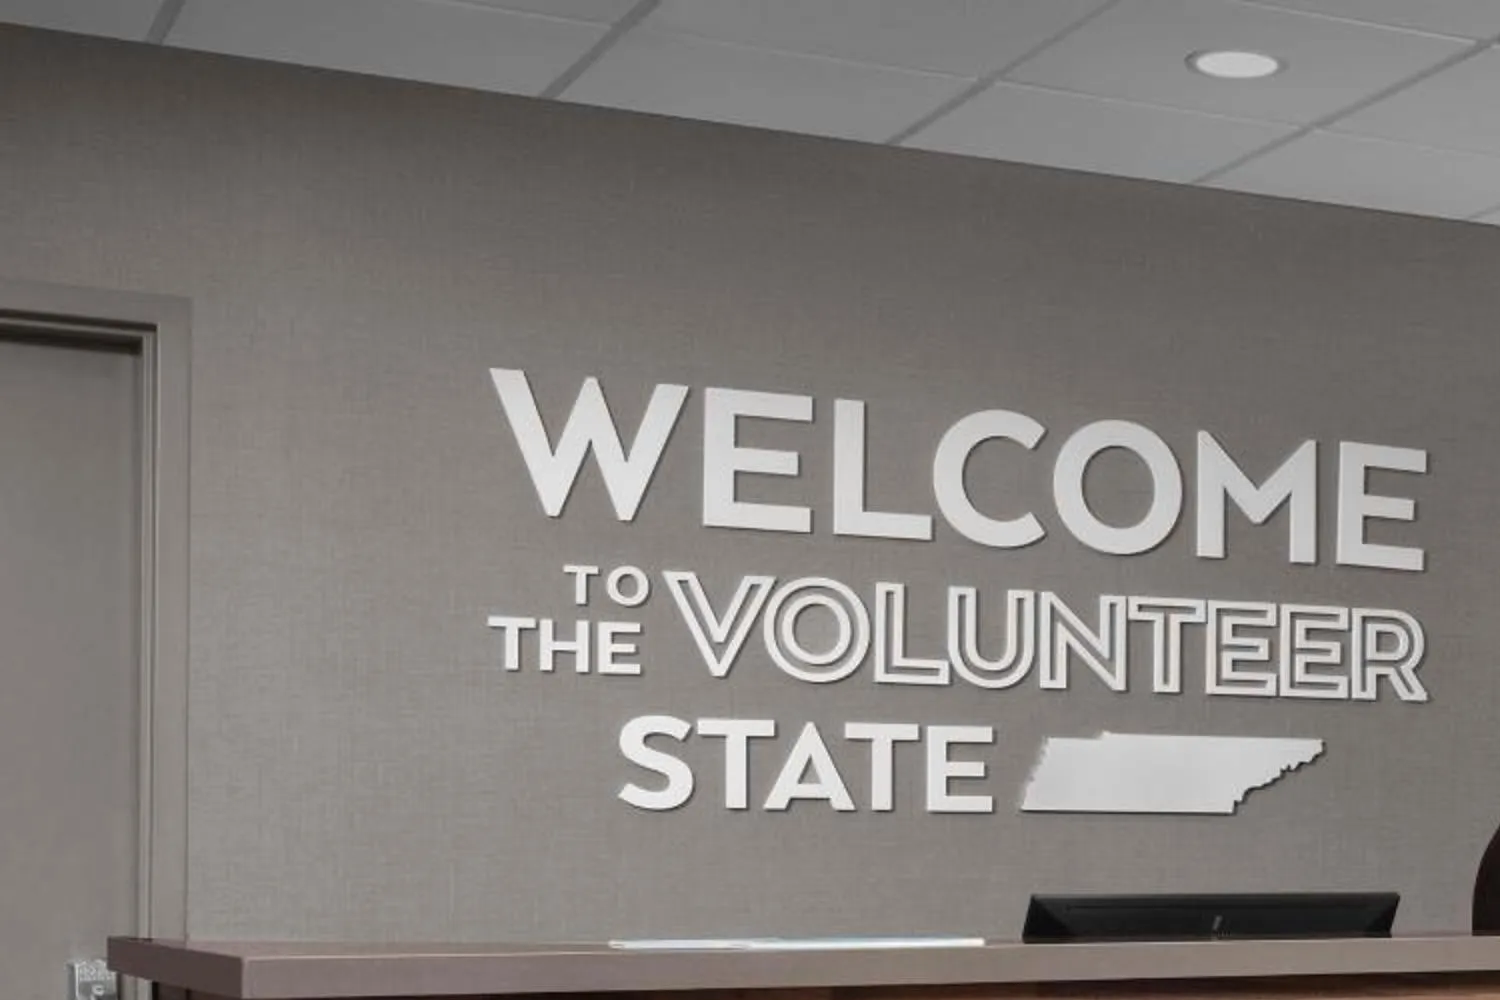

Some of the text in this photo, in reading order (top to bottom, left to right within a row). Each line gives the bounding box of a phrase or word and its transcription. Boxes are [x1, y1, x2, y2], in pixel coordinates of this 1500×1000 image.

[490, 368, 1429, 571] WELCOME
[487, 571, 1429, 702] THE VOLUNTEER
[563, 564, 651, 608] TO
[617, 715, 995, 814] STATE
